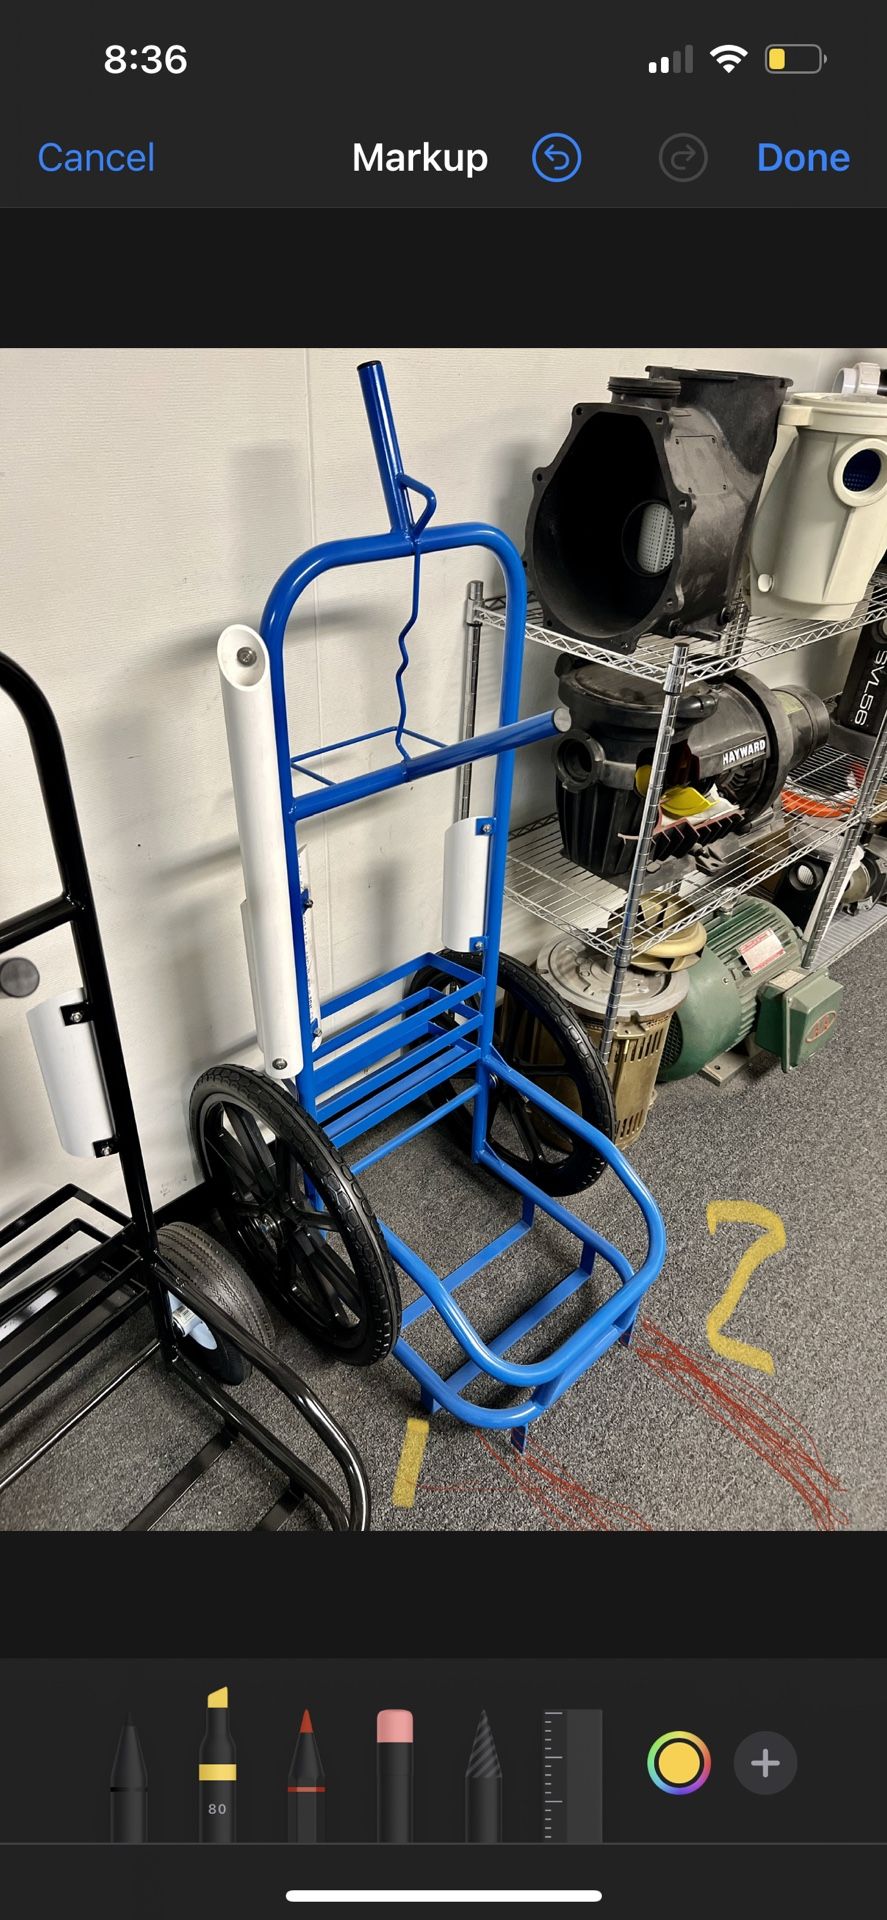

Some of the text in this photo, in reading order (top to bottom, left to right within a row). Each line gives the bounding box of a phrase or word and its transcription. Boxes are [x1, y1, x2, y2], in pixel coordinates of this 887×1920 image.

[104, 45, 188, 75] 8:36
[37, 140, 155, 173] Cancel
[353, 141, 489, 179] Markup
[757, 142, 852, 173] Done
[722, 739, 766, 766] HAYWARD
[208, 1802, 227, 1817] 80
